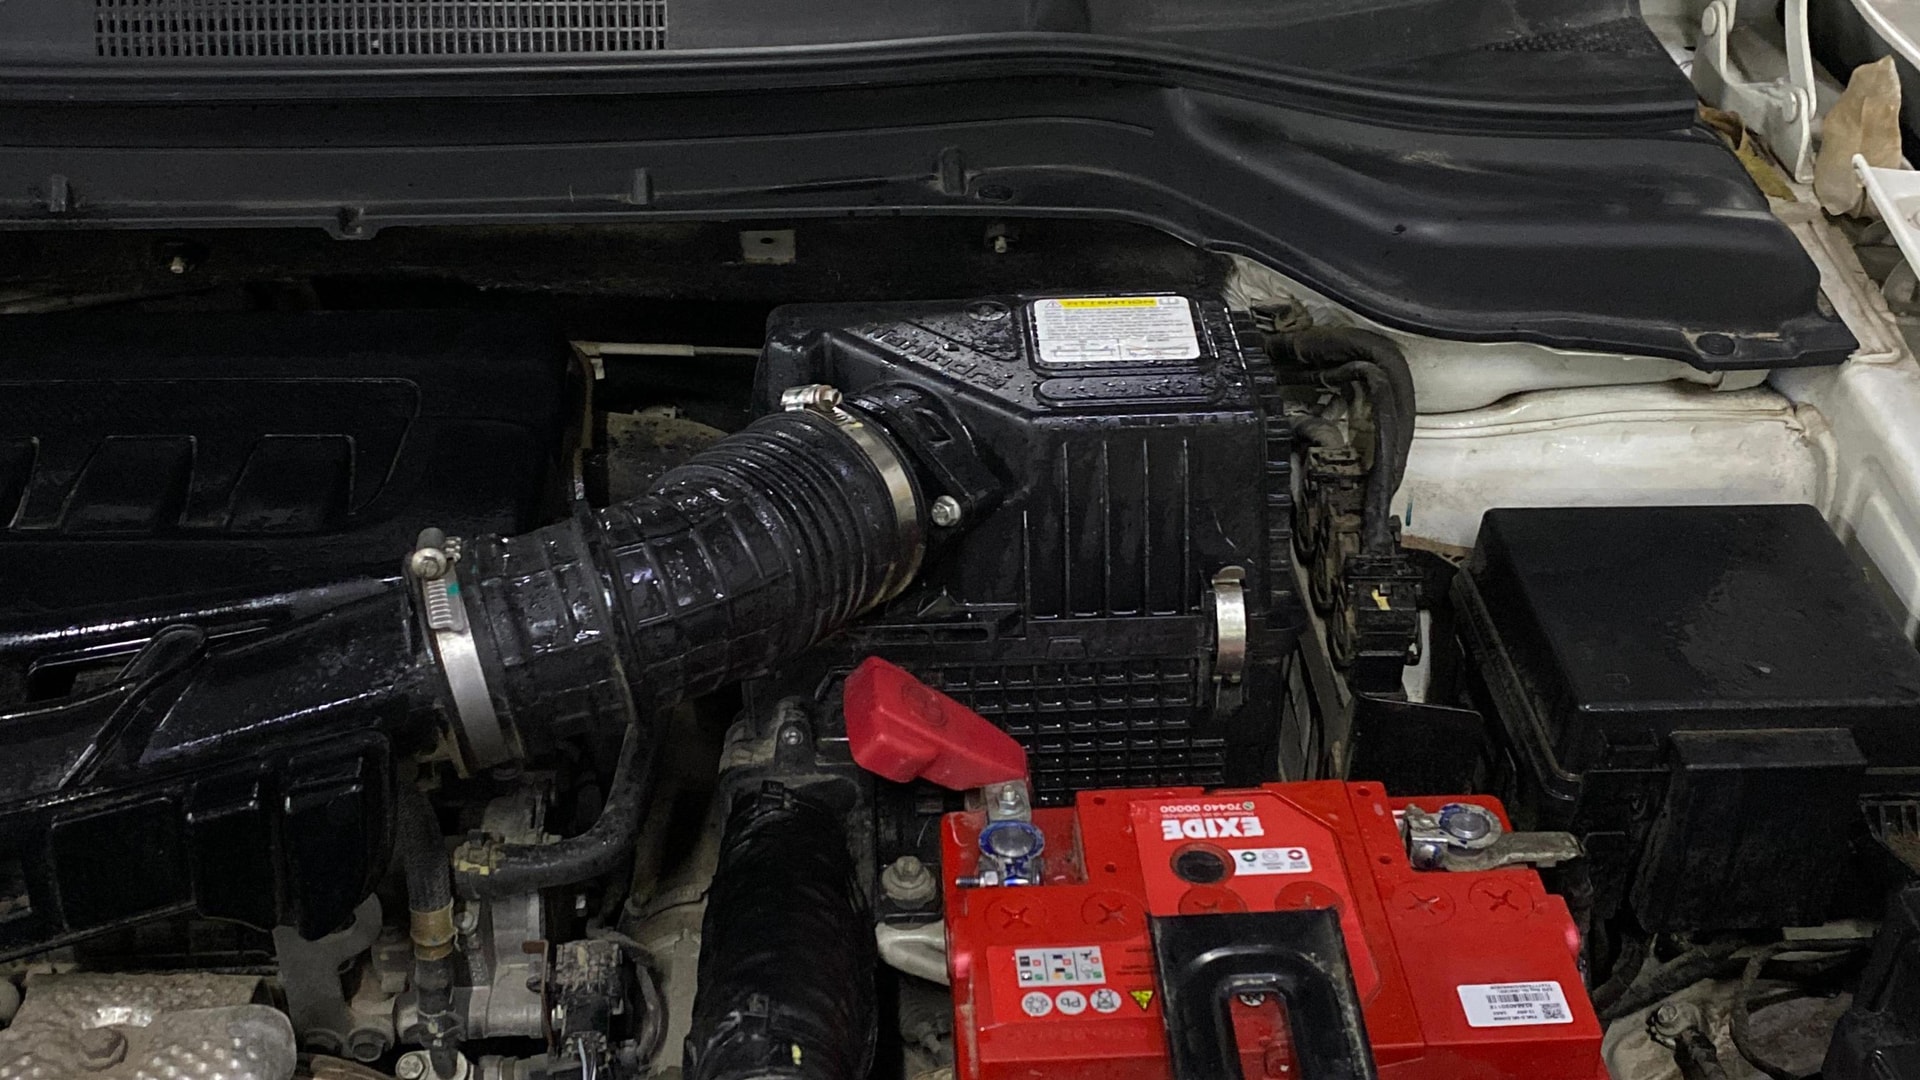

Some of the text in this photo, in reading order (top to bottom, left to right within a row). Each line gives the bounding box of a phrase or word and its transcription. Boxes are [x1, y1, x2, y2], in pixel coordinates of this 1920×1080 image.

[1160, 803, 1242, 813] 70440 00000
[1161, 816, 1264, 841] EXIDE
[1060, 996, 1081, 1008] Pb
